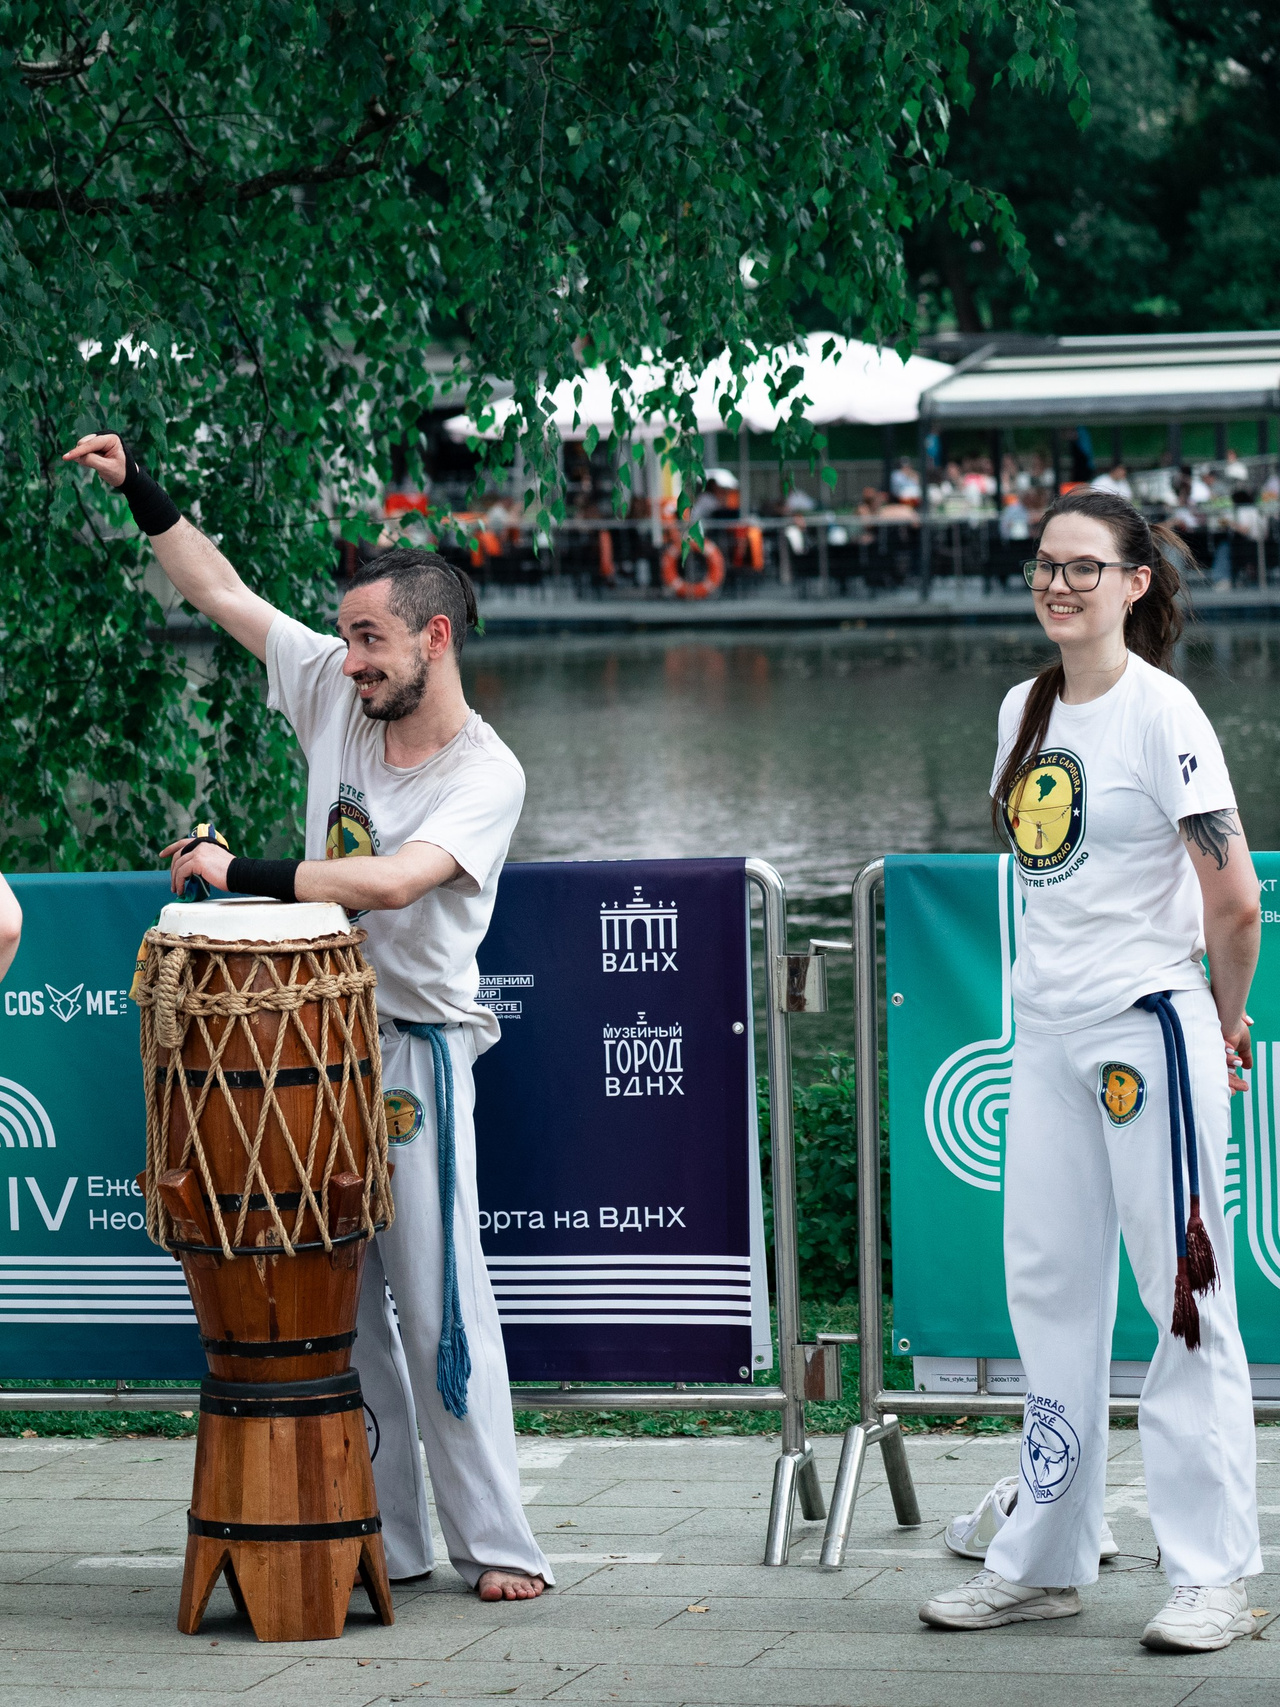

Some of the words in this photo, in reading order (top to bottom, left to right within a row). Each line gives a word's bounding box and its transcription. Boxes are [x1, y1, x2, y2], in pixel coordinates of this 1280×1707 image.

[1039, 754, 1058, 765] AXÉ
[1059, 757, 1081, 795] CAPOEIRA
[340, 783, 365, 802] STRE
[340, 803, 365, 825] RUPO
[1037, 842, 1071, 868] BARRÃO
[1046, 851, 1089, 887] PARAFUSO
[602, 951, 679, 973] ВДНХ
[479, 977, 531, 985] ЗМЕНИМ
[4, 990, 45, 1016] COS
[119, 990, 128, 1015] 1618
[603, 1038, 684, 1075] ГОРОД
[605, 1075, 685, 1097] ВДНХ
[8, 1176, 79, 1232] IV
[89, 1209, 148, 1231] Нео
[478, 1209, 546, 1234] орта
[554, 1209, 590, 1229] на
[599, 1205, 687, 1232] ВДНХ
